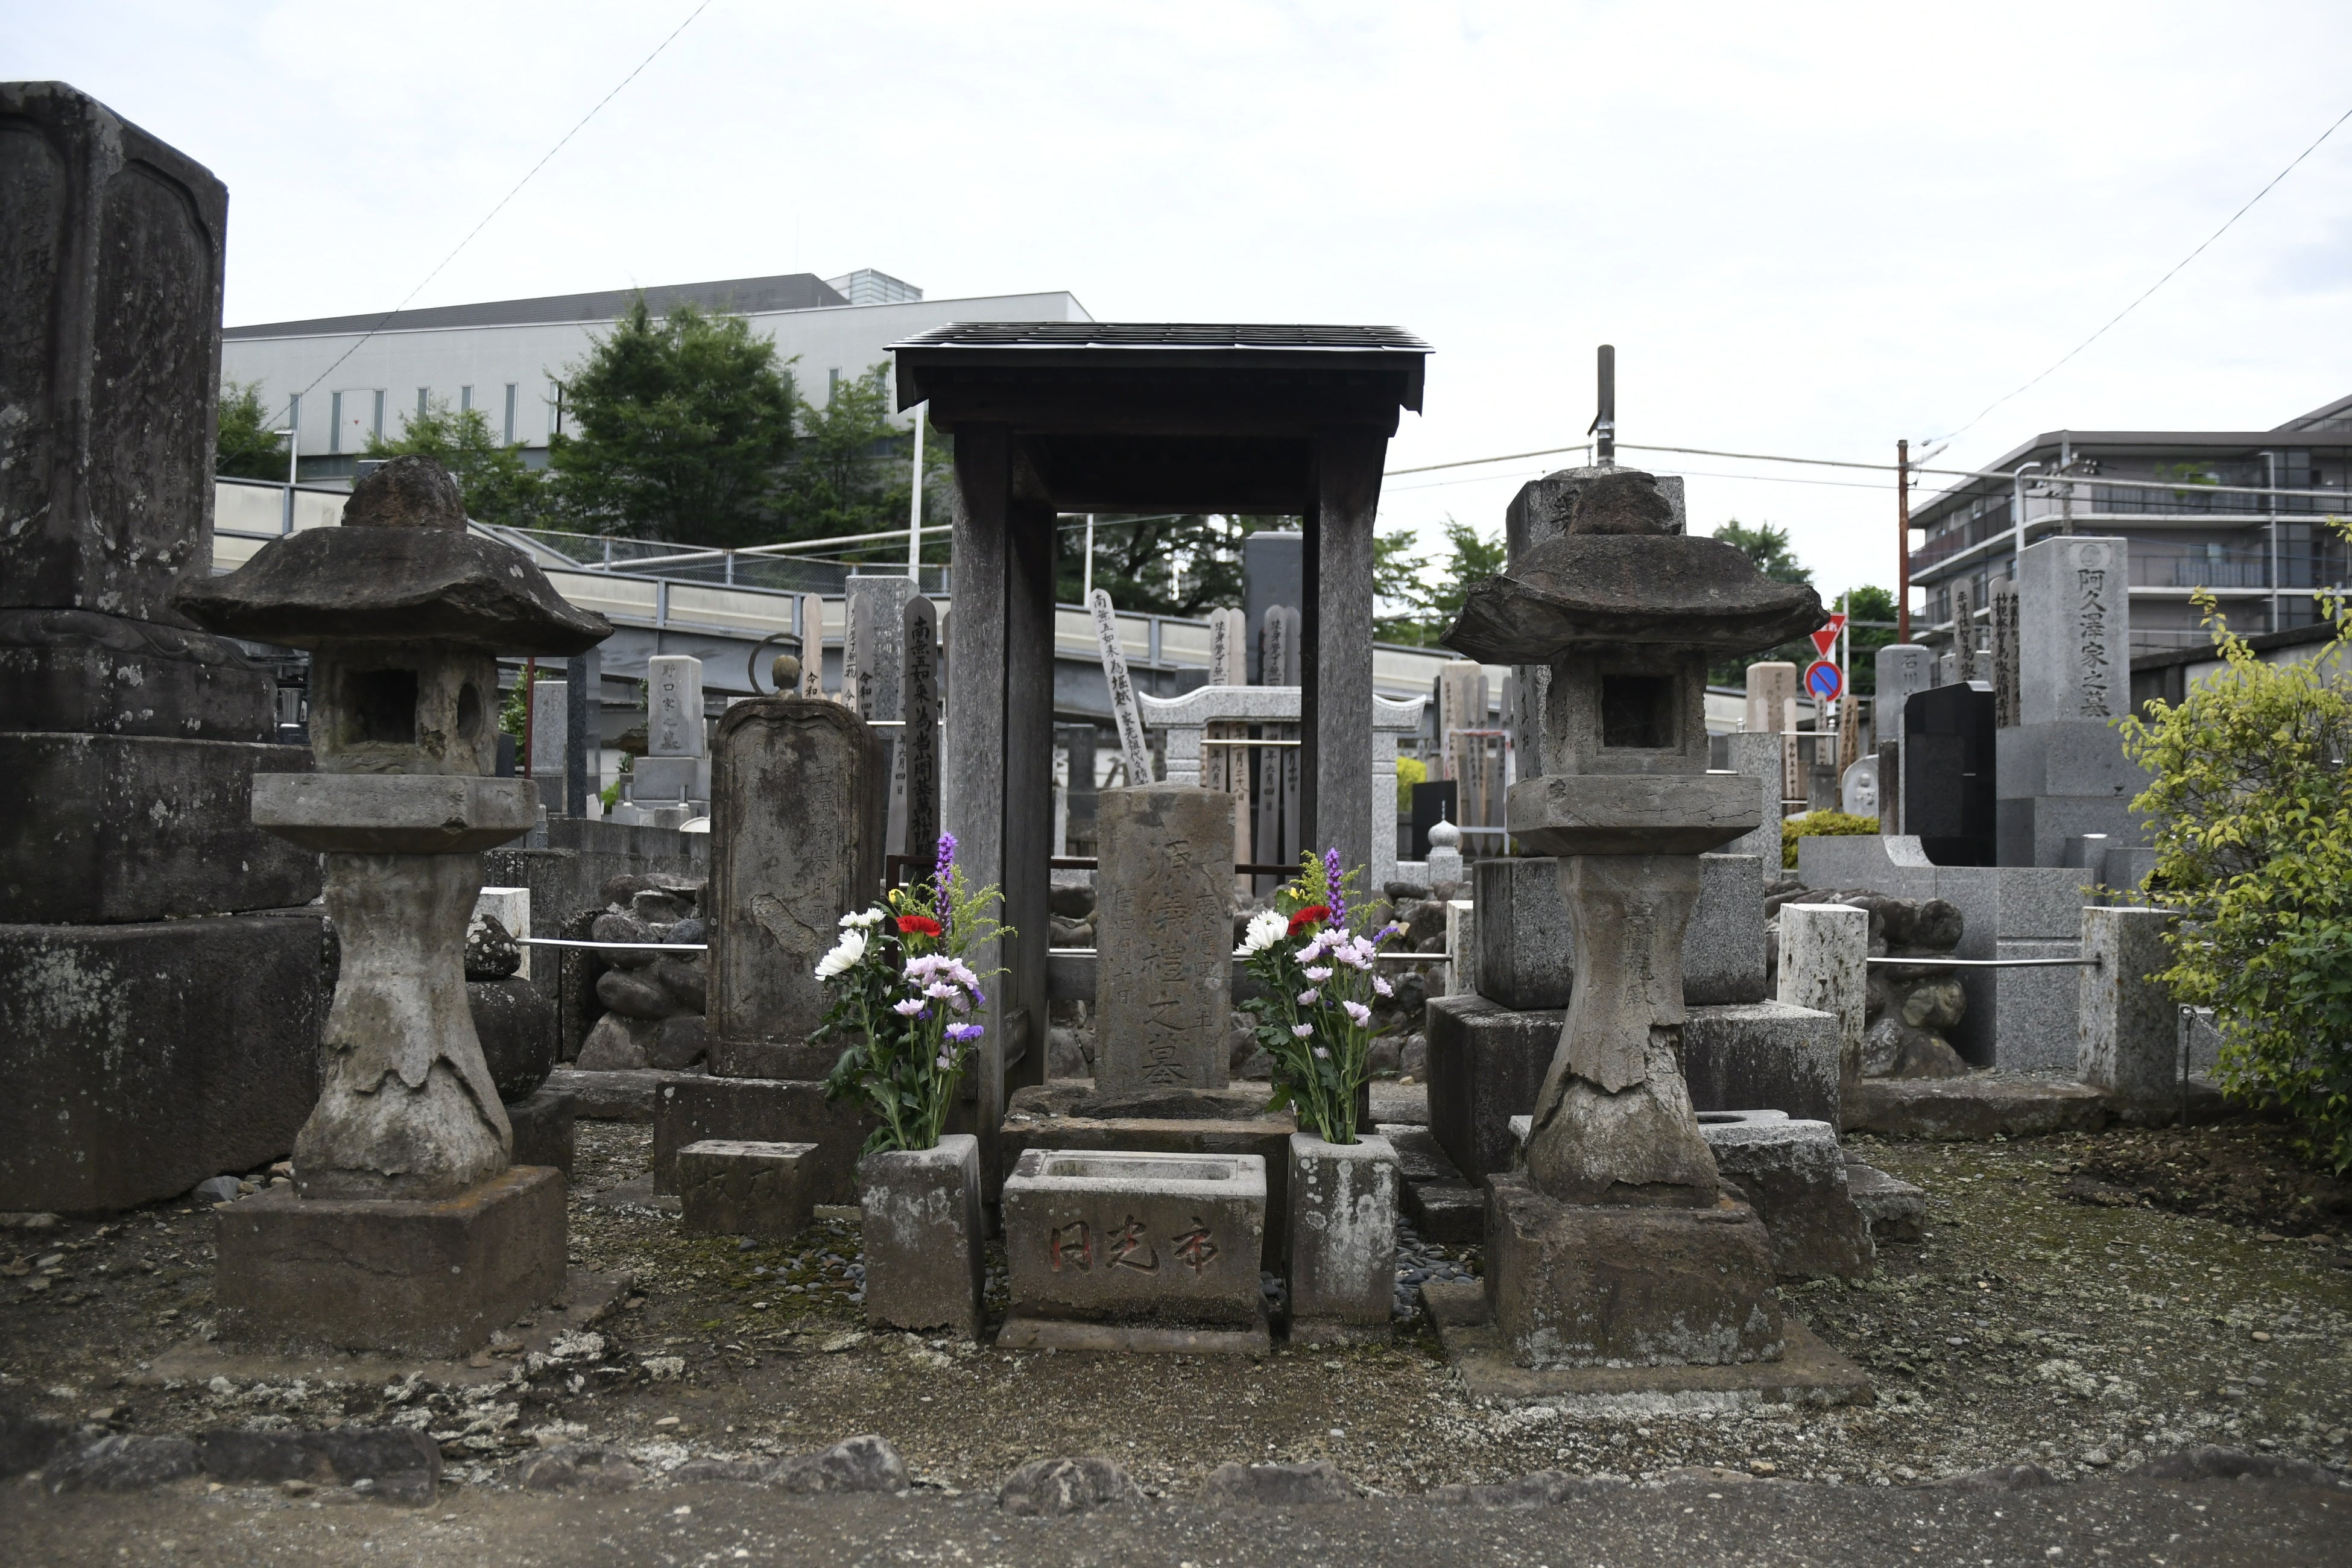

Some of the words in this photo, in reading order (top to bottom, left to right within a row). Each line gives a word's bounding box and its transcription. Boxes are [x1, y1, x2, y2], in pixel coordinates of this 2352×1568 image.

[806, 671, 818, 698] 令和
[2077, 569, 2111, 718] 阿久澤家之墓
